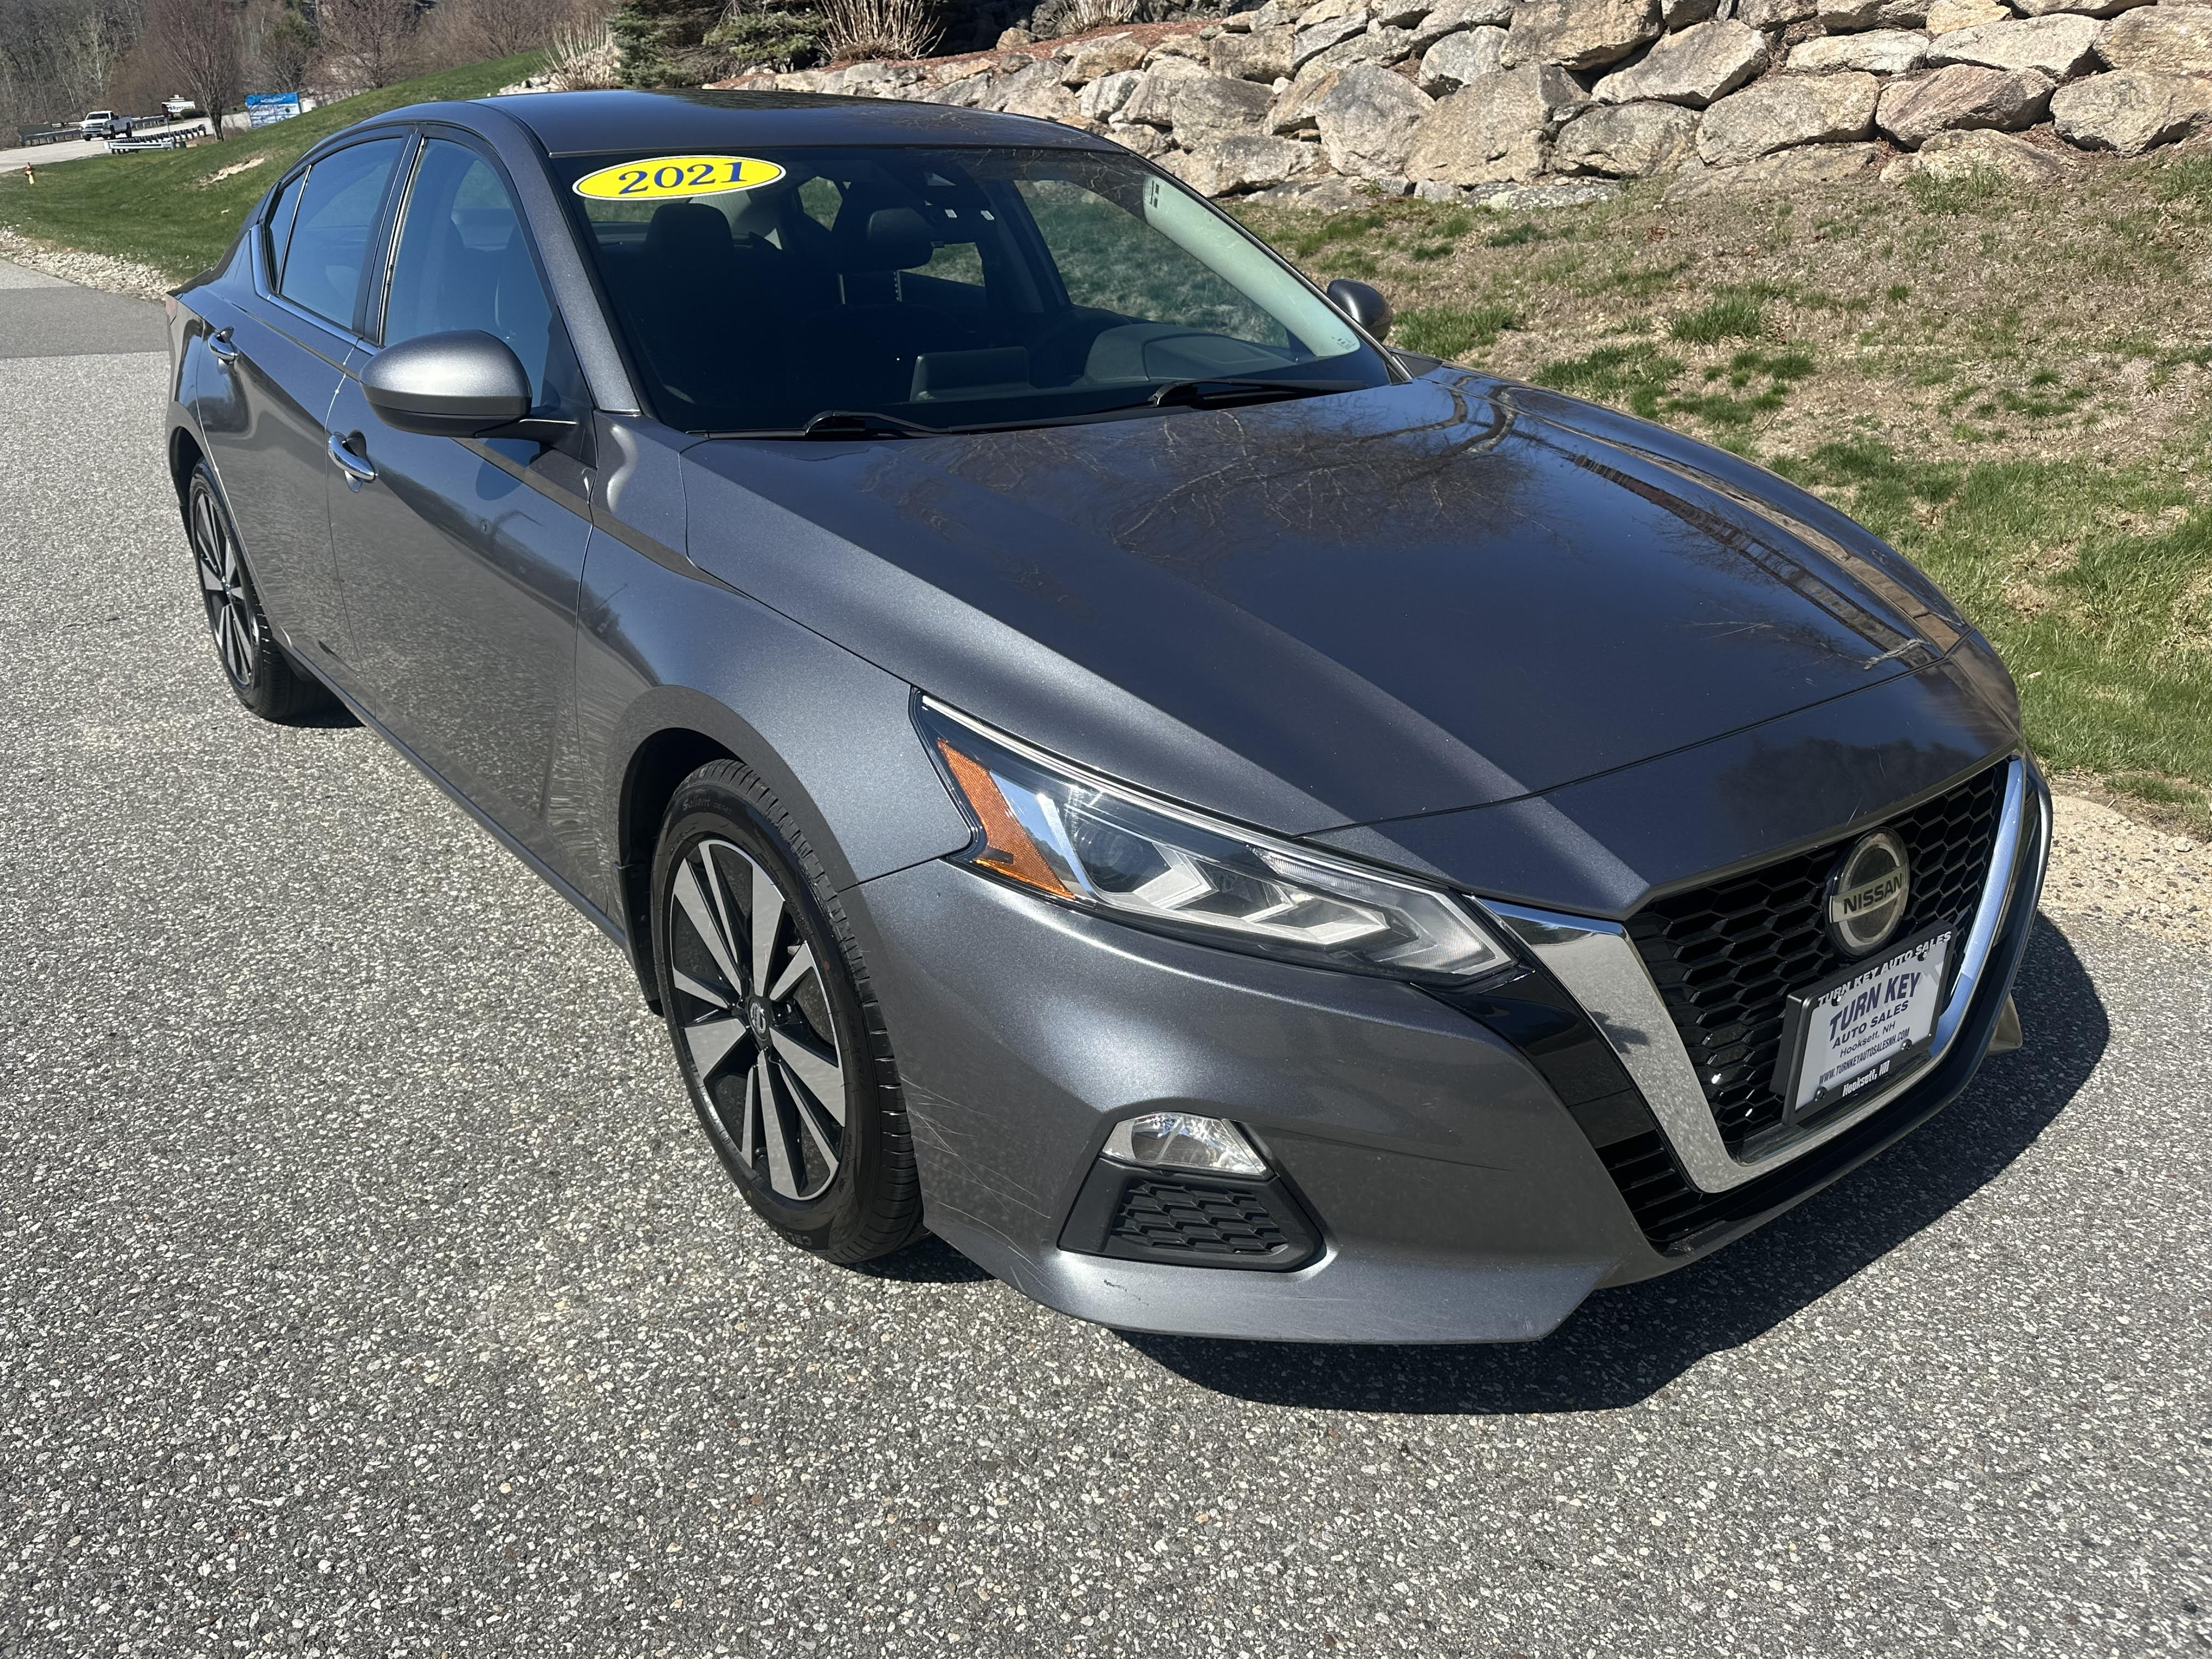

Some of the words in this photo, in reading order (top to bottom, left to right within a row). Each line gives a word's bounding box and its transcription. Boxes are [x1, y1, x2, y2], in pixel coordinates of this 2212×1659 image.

[618, 161, 747, 195] 2021
[1843, 873, 1903, 915] NISSAN
[1818, 981, 1852, 1007] TURN
[1854, 967, 1880, 988] KEY
[1881, 950, 1914, 974] AUTO
[1916, 931, 1952, 955] SALES
[1830, 982, 1882, 1041] TURN
[1884, 972, 1921, 1004] KEY
[1832, 1022, 1867, 1049] AUTO
[1870, 1000, 1909, 1028] SALES
[1819, 1027, 1910, 1085] WWW.TURNKEYAUTOSALESNH.COM
[1839, 1031, 1880, 1058] Hooksett,
[1882, 1021, 1896, 1034] NH
[1842, 1069, 1877, 1097] Hooksett,
[1879, 1060, 1891, 1076] NH
